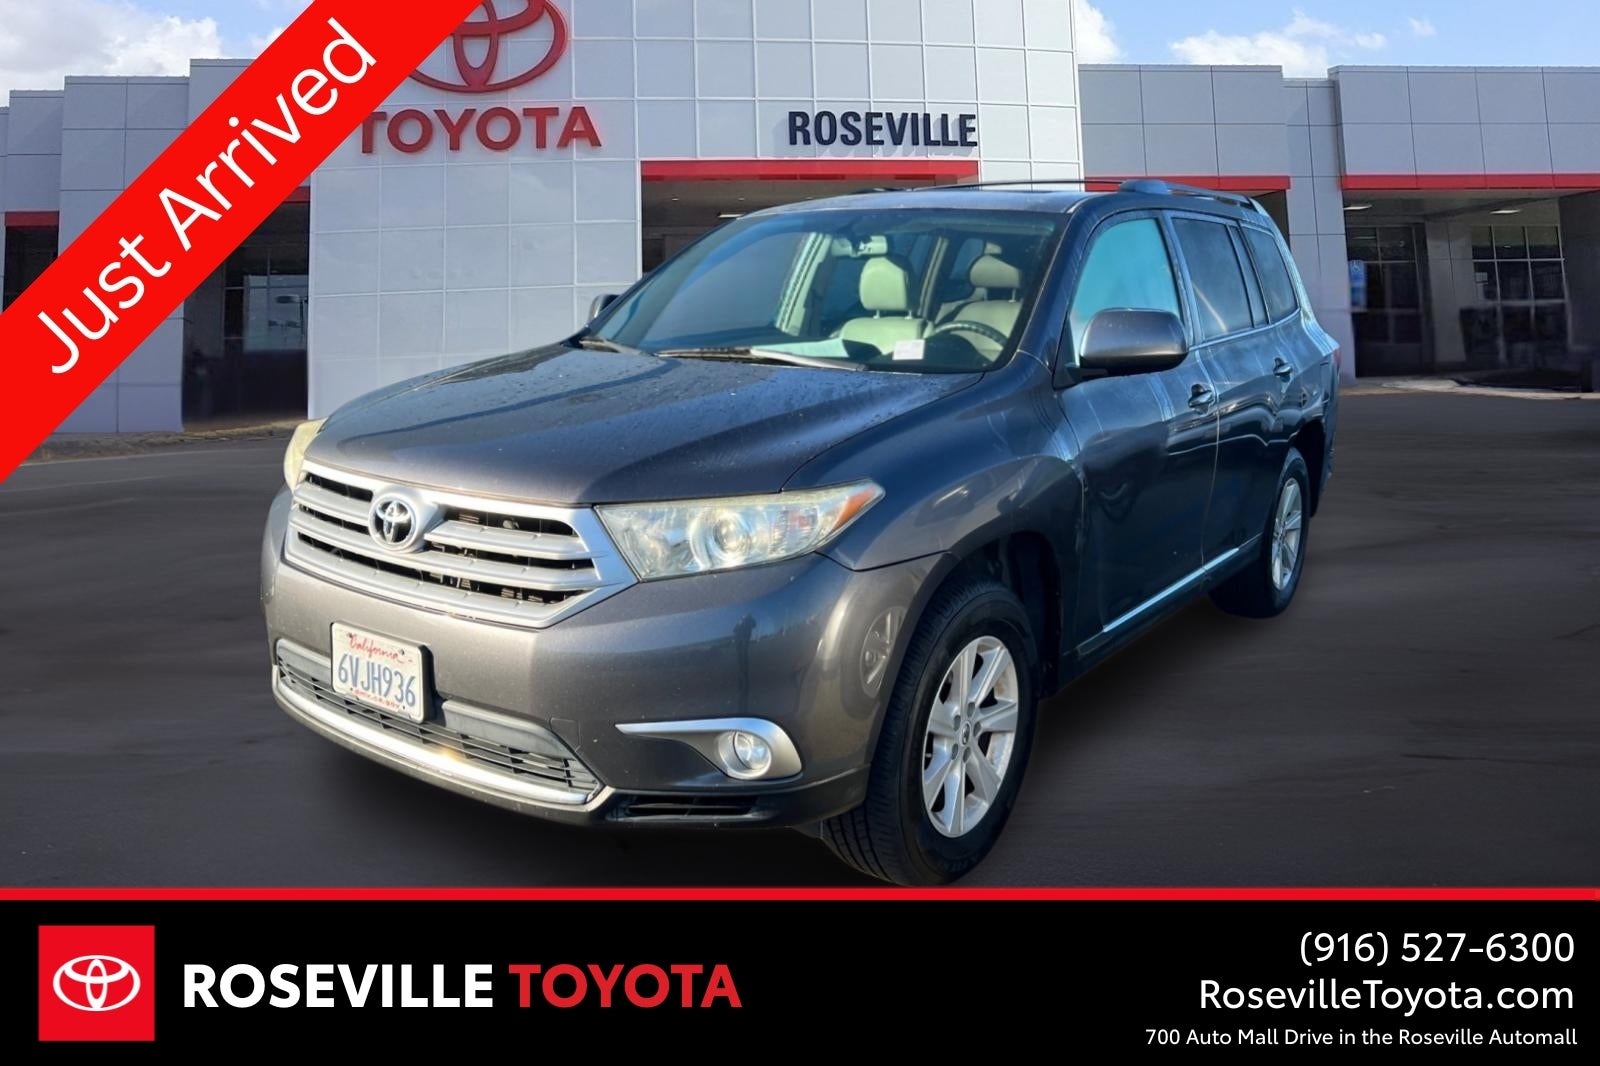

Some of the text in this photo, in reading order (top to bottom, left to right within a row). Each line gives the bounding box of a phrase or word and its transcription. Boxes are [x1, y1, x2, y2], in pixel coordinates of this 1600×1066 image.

[361, 107, 602, 154] TOYOTA
[788, 110, 978, 147] ROSEVILLE
[338, 653, 416, 707] 6VJH936
